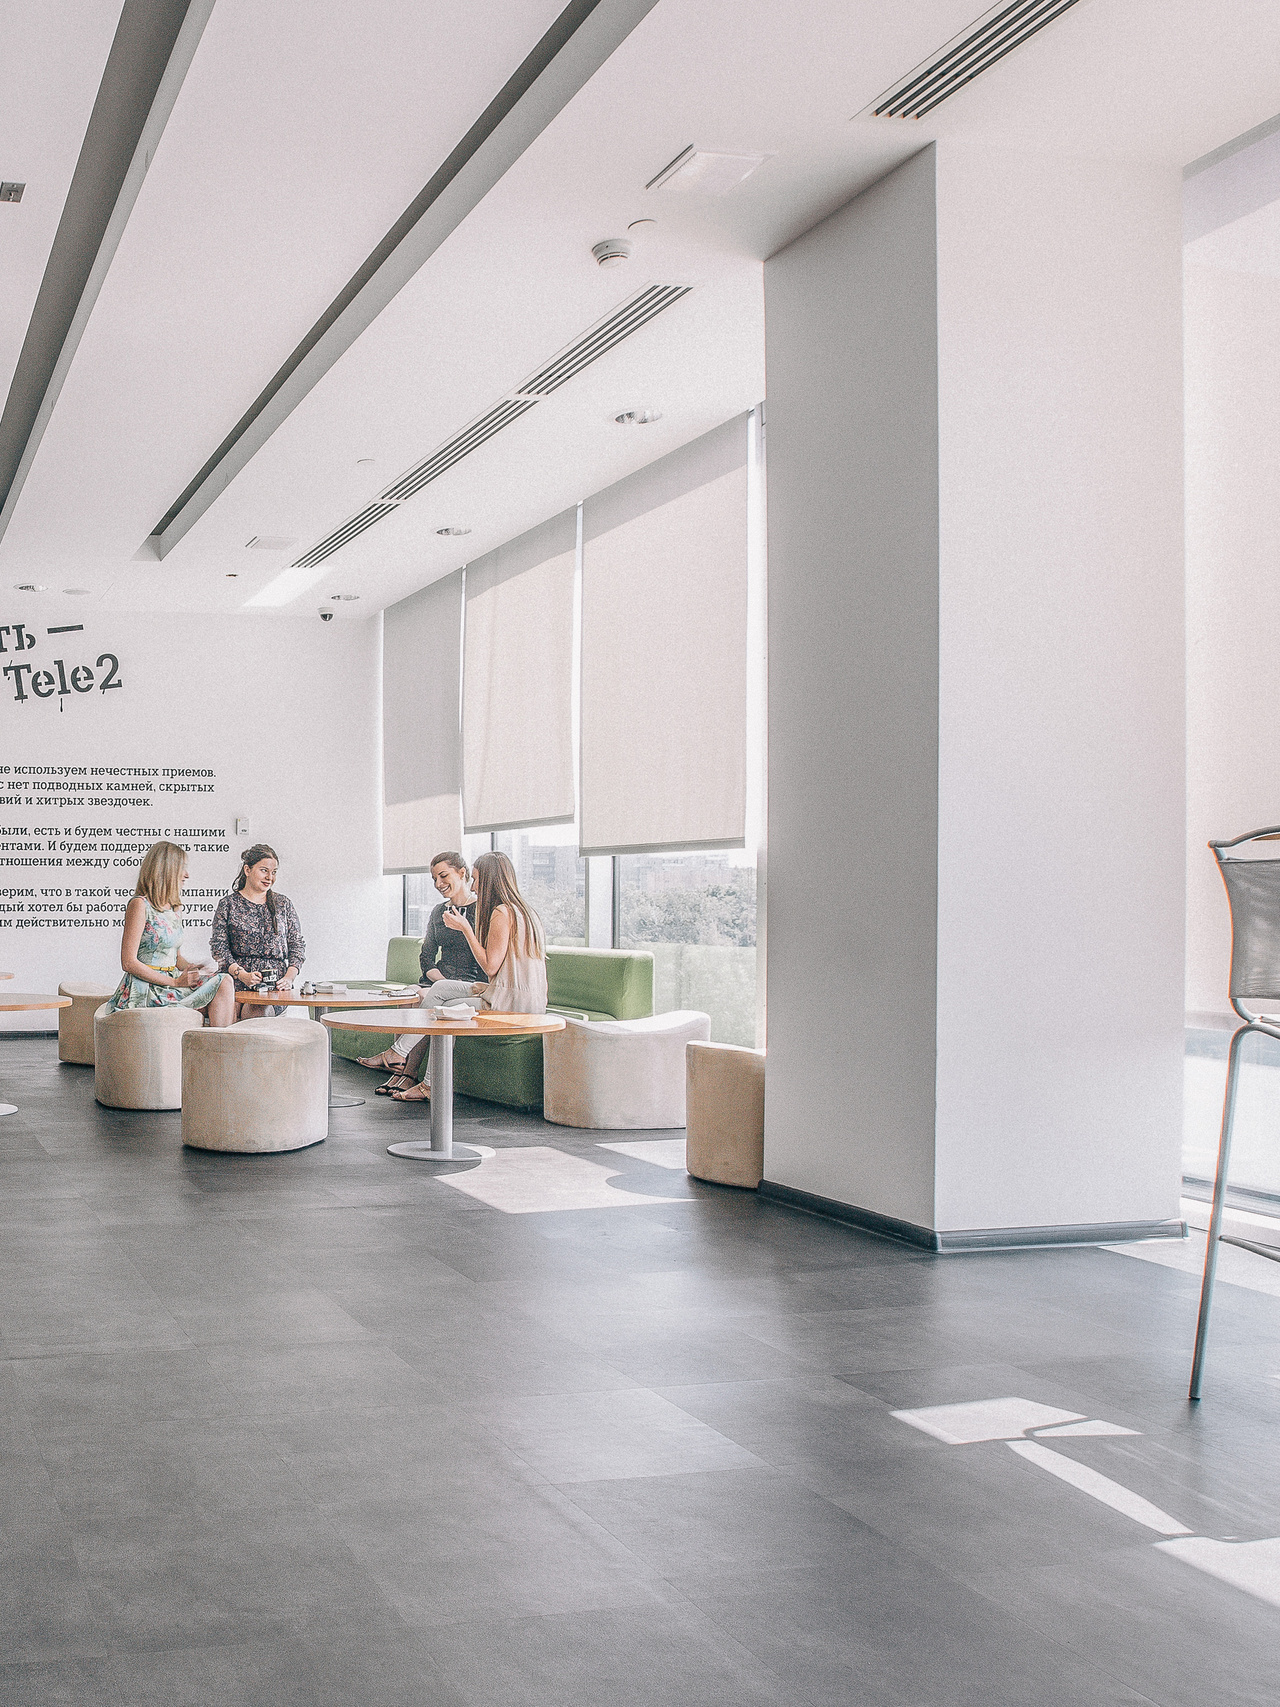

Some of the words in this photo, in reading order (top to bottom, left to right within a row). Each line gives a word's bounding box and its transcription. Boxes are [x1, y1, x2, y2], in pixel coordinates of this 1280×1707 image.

[2, 653, 123, 706] Tele2
[13, 765, 88, 779] используем
[90, 767, 159, 777] нечестных
[162, 768, 217, 780] приемов.
[7, 781, 30, 791] нет
[32, 781, 103, 793] подводных
[106, 780, 156, 792] камней,
[158, 783, 215, 795] скрытых
[25, 796, 33, 806] и
[36, 796, 85, 808] хитрых
[87, 797, 153, 808] звездочек.
[33, 827, 61, 836] есть
[63, 827, 72, 836] и
[74, 825, 113, 839] будем
[115, 827, 162, 837] честны
[164, 828, 171, 837] с
[173, 828, 226, 838] нашими
[47, 840, 57, 851] И
[59, 840, 98, 854] будем
[100, 843, 191, 854] поддерть
[193, 843, 230, 853] такие
[65, 857, 110, 869] между
[40, 888, 63, 897] что
[65, 888, 72, 897] в
[74, 886, 111, 897] такой
[27, 903, 64, 913] хотел
[66, 901, 83, 913] бы
[15, 916, 110, 929] действительно
